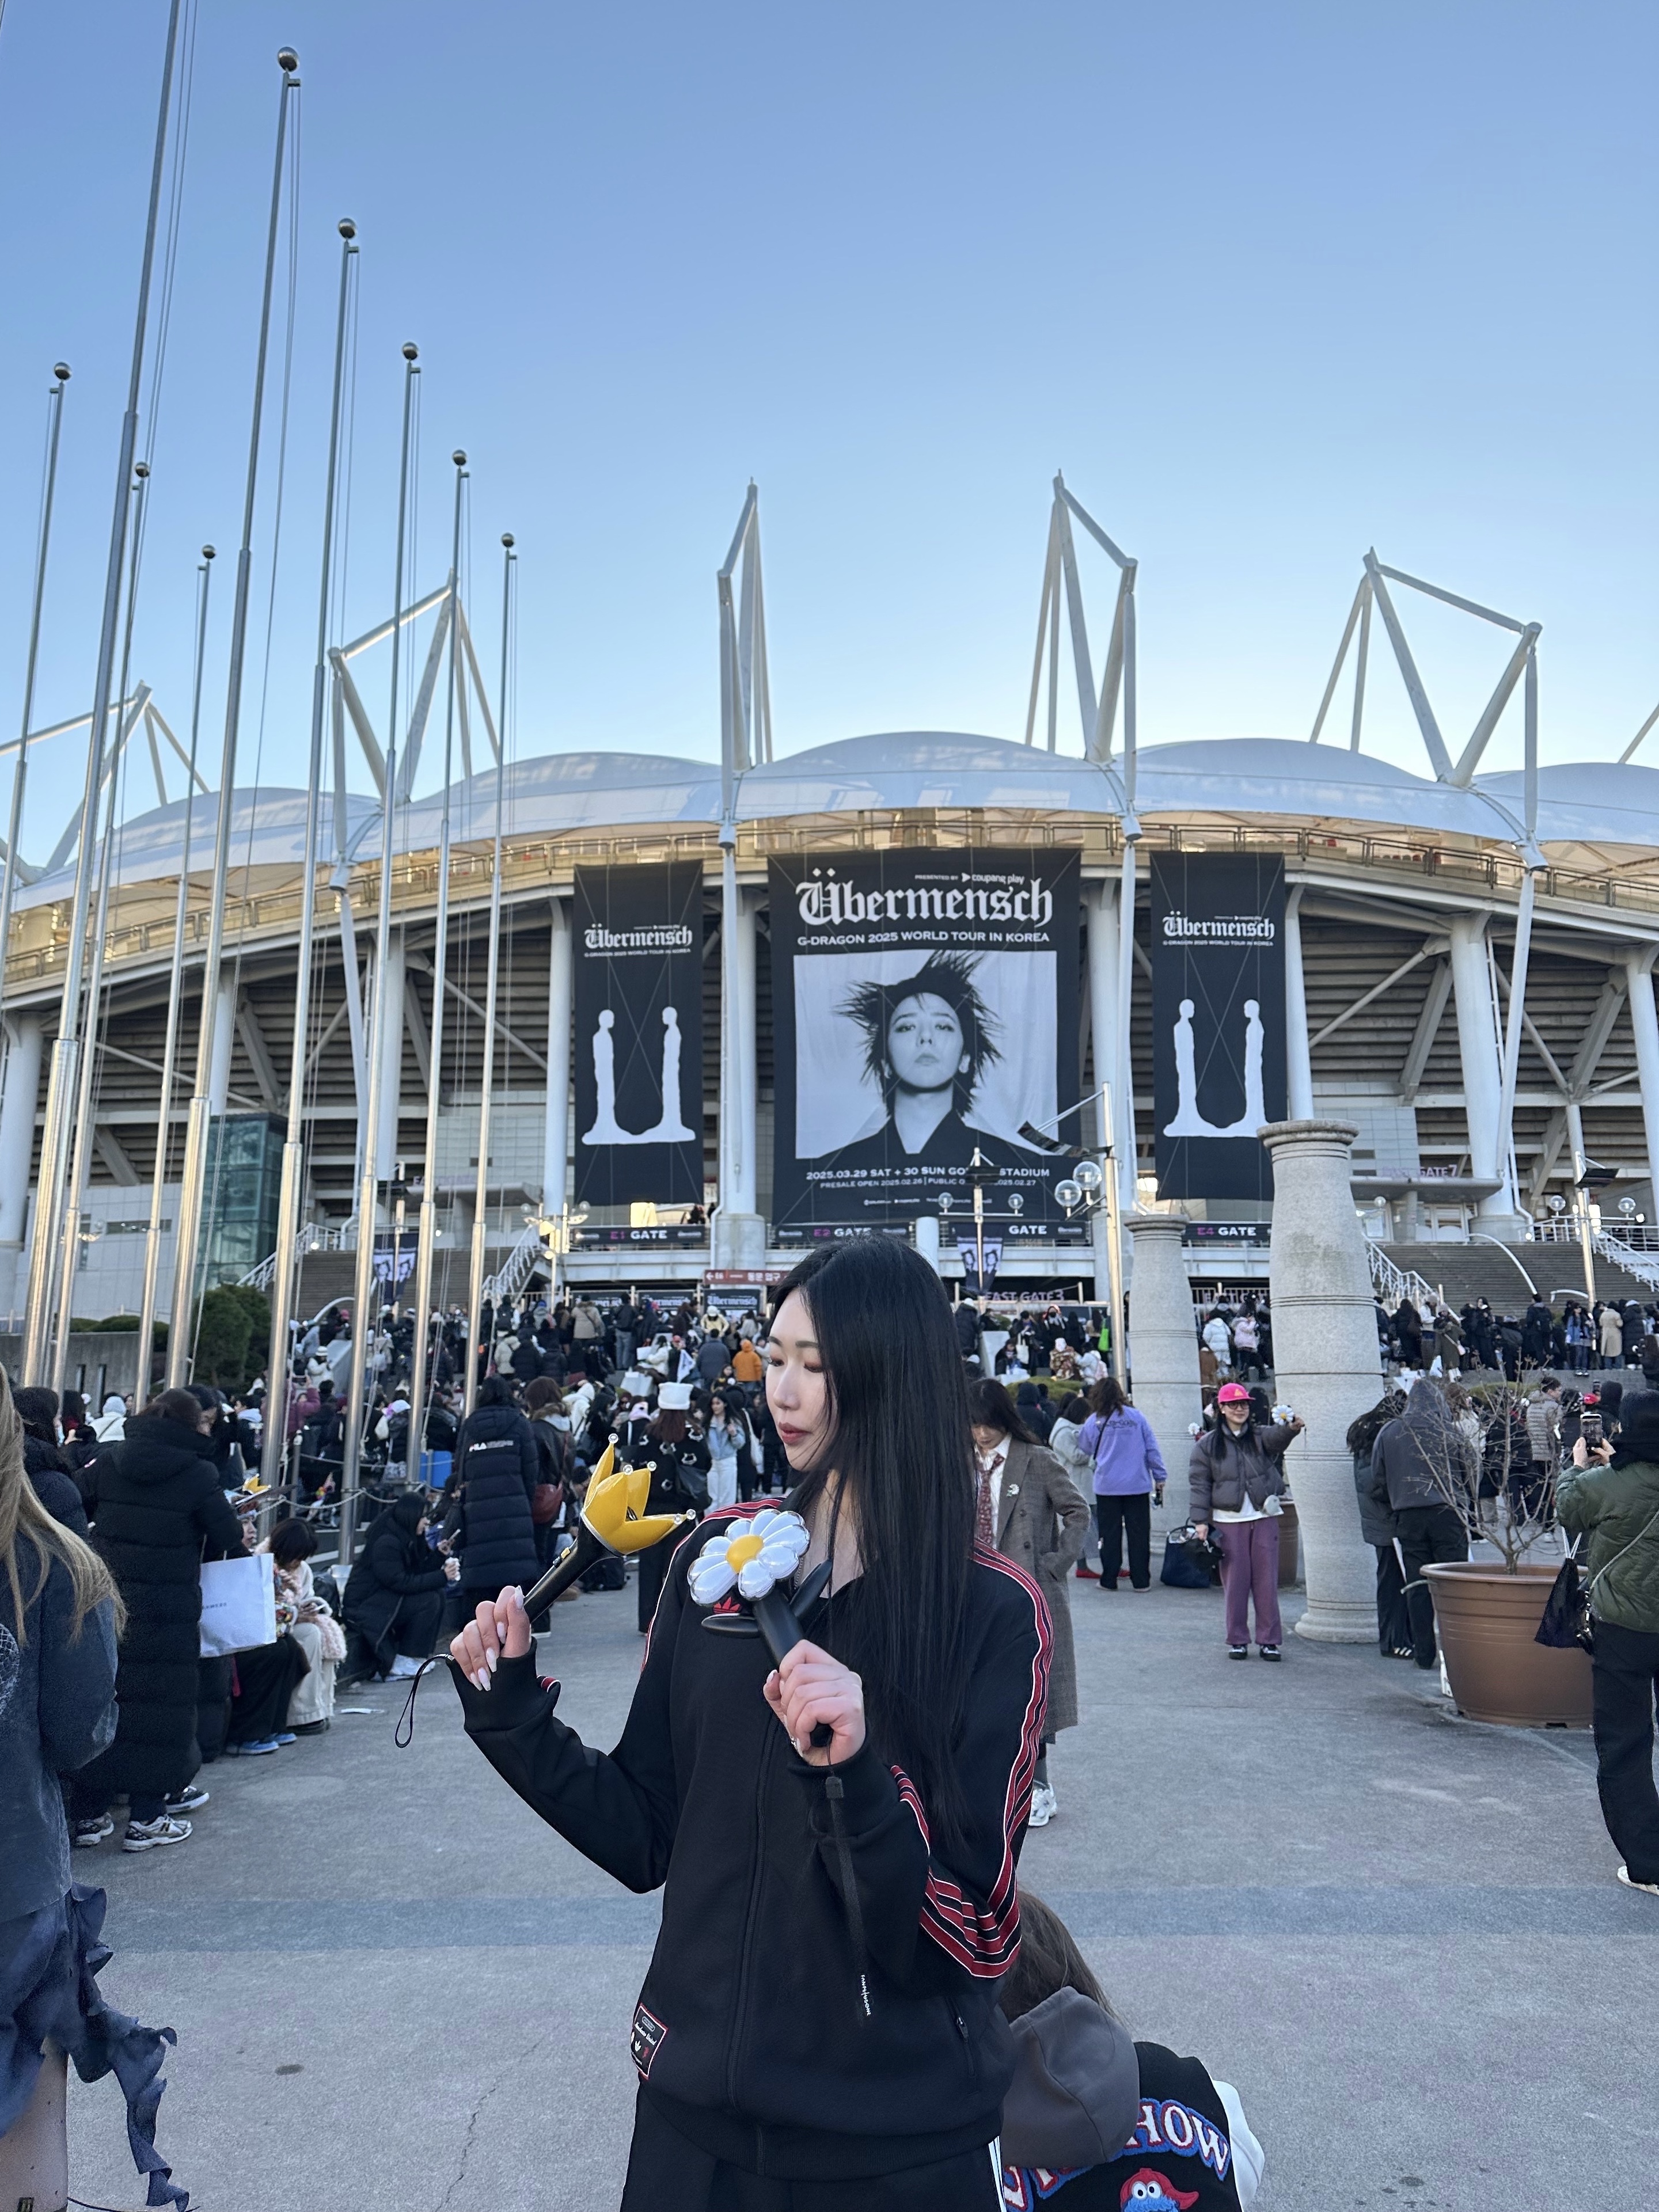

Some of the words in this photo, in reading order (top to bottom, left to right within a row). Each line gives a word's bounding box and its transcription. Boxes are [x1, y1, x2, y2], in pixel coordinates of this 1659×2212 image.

[971, 873, 1006, 885] coupang
[1007, 873, 1025, 885] play
[795, 868, 1053, 928] Übermensch
[1162, 910, 1275, 940] Übermensch
[584, 923, 693, 949] Übermensch
[798, 934, 865, 946] G-DRAGON
[868, 932, 898, 943] 2025
[901, 930, 948, 941] WORLD
[950, 931, 986, 942] TOUR
[989, 932, 1004, 942] IN
[1005, 932, 1050, 943] KOREA
[806, 1169, 868, 1180] 2025.03.29
[870, 1168, 892, 1177] SAT
[903, 1167, 919, 1176] 30
[921, 1166, 946, 1176] SUN
[999, 1168, 1050, 1177] STADIUM
[820, 1180, 856, 1189] PRESALE
[610, 1231, 625, 1240] E1
[630, 1230, 667, 1240] GATE
[813, 1228, 831, 1237] E2
[834, 1227, 872, 1237] GATE
[1008, 1225, 1047, 1235] GATE
[1197, 1227, 1214, 1236] E4
[1218, 1226, 1256, 1236] GATE
[1121, 2099, 1232, 2179] HOW
